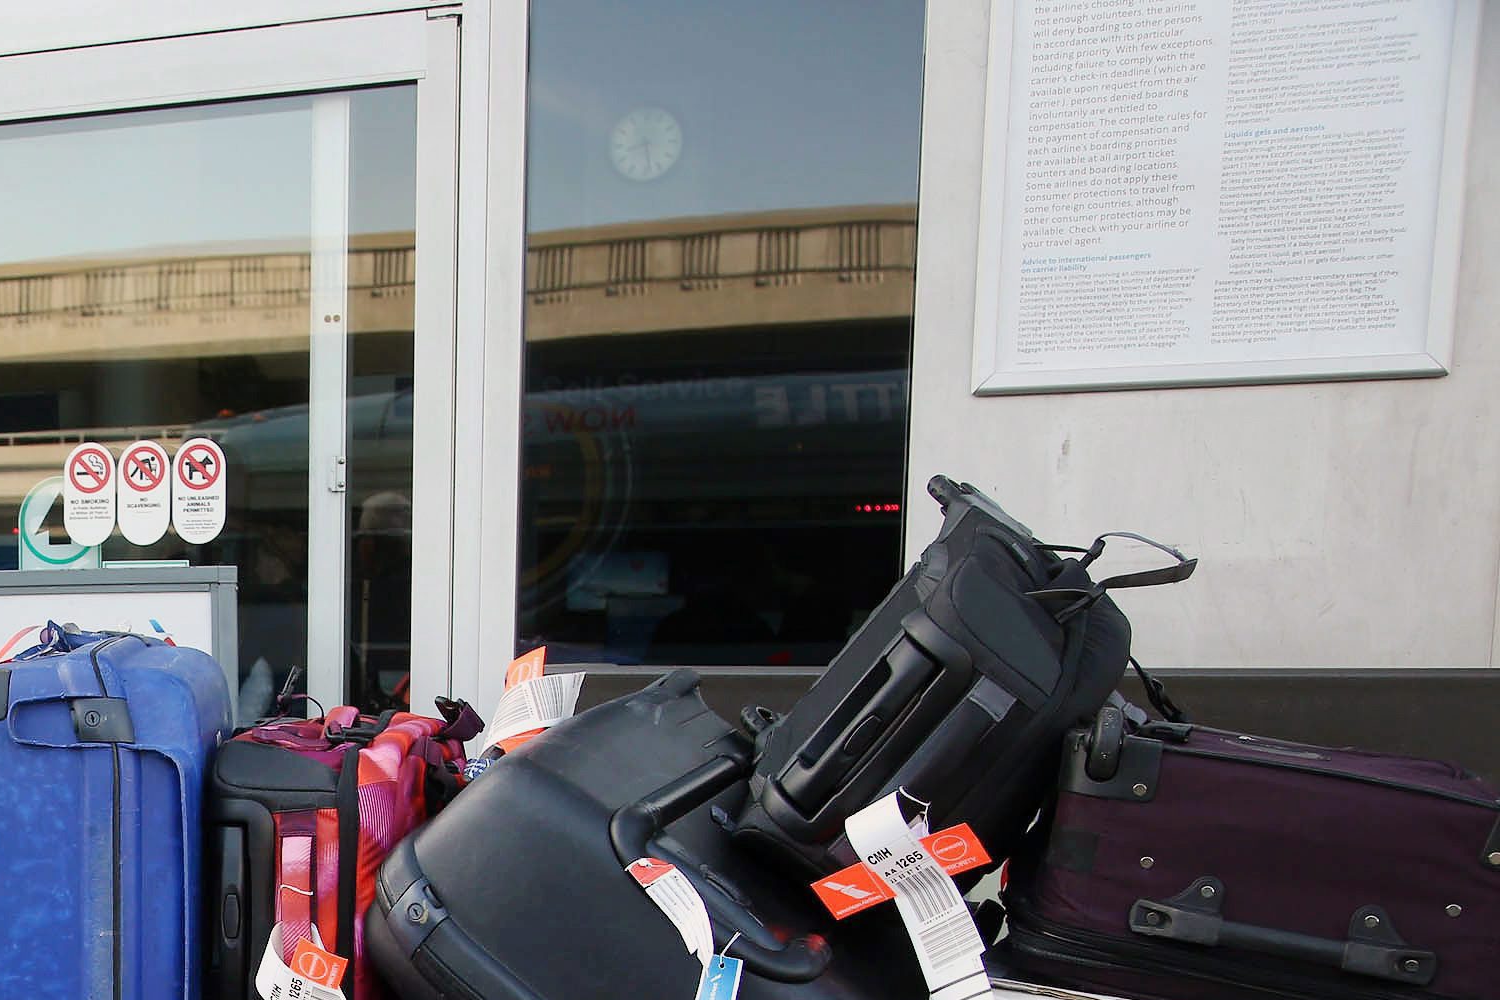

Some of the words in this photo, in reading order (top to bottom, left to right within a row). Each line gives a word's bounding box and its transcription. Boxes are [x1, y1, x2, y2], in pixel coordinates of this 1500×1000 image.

[868, 848, 892, 865] CMH
[884, 868, 897, 878] AA
[896, 850, 924, 869] 1265
[289, 978, 302, 999] 1265
